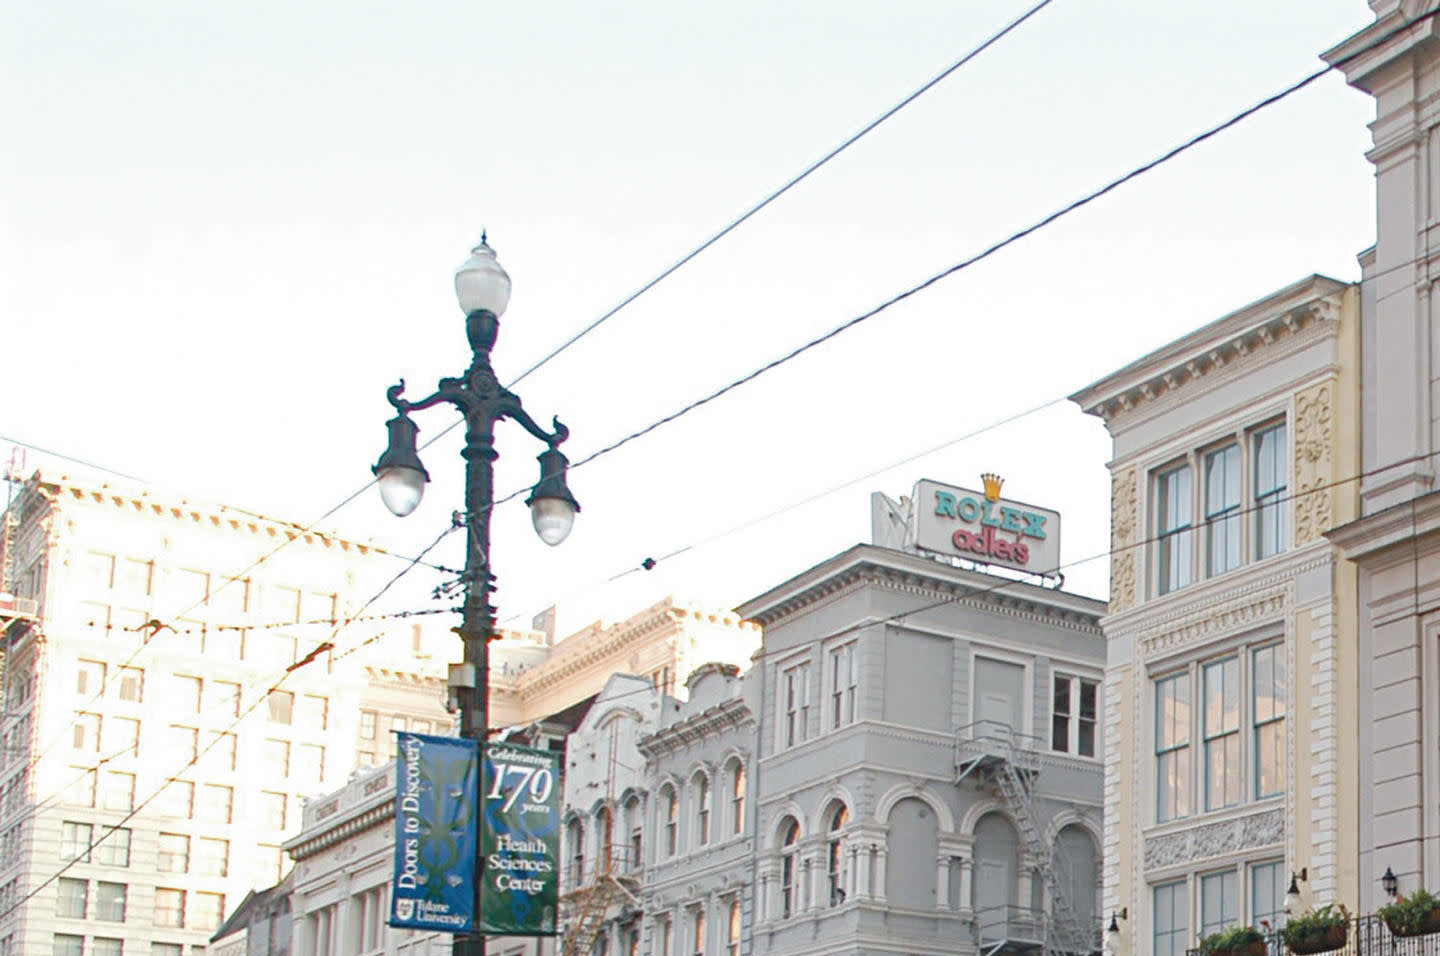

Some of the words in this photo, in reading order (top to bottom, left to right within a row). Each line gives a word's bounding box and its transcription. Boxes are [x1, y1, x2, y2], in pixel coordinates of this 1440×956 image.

[935, 490, 1047, 539] ROLEX
[487, 747, 552, 768] Celebrating
[401, 735, 424, 813] Discovery
[404, 818, 419, 833] to
[497, 836, 547, 854] Health
[398, 836, 419, 890] Doors
[488, 855, 553, 872] Sciences
[496, 875, 546, 893] Center
[416, 899, 450, 912] Tulane
[416, 911, 468, 928] University
